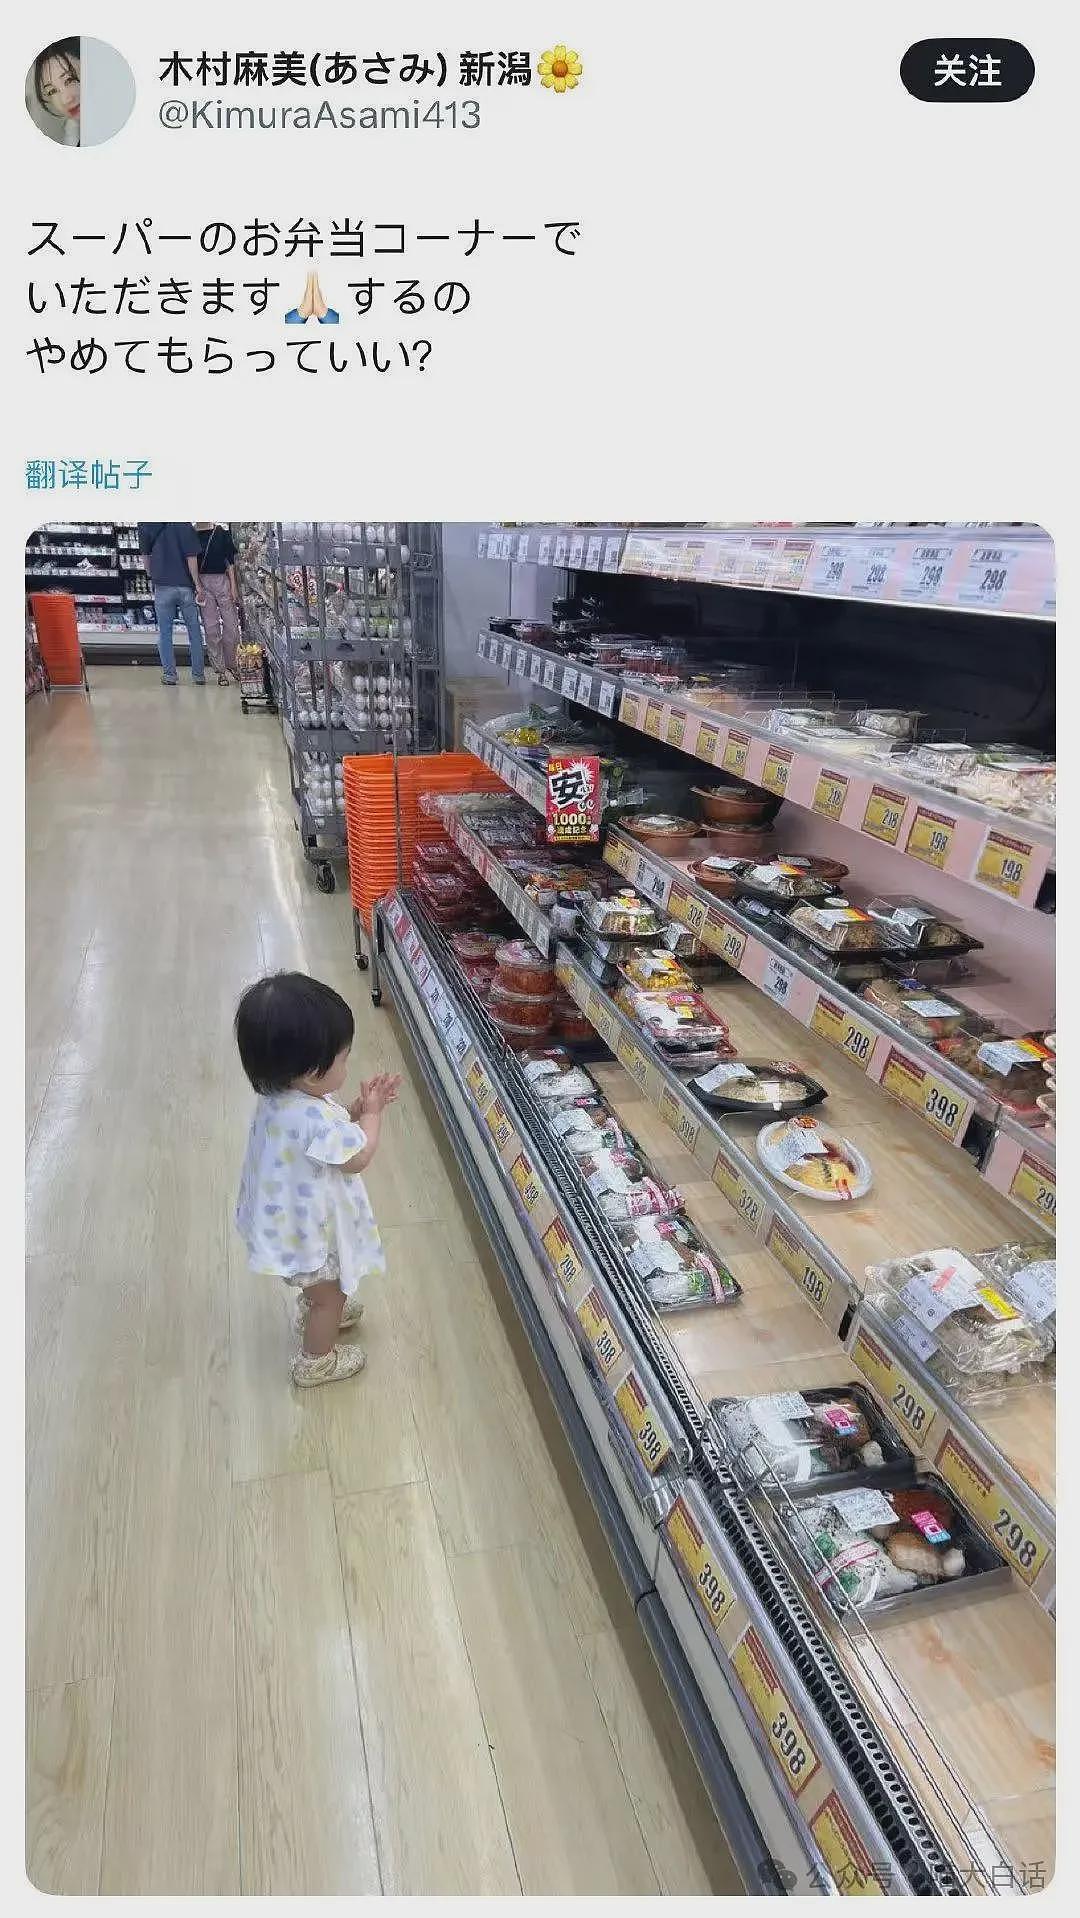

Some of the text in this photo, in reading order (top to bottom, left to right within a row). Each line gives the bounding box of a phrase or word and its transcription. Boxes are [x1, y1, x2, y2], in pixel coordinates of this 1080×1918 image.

[919, 565, 943, 586] 298
[980, 568, 1008, 591] 298
[882, 808, 899, 829] 218
[1000, 859, 1023, 882] 198
[724, 933, 742, 958] 298
[843, 1025, 871, 1060] 298
[924, 1087, 960, 1128] 398
[802, 1266, 825, 1302] 198
[597, 1330, 616, 1365] 398
[892, 1384, 926, 1431] 298
[639, 1421, 662, 1461] 398
[992, 1508, 1038, 1568] 298
[699, 1561, 726, 1615] 398
[771, 1710, 807, 1776] 398
